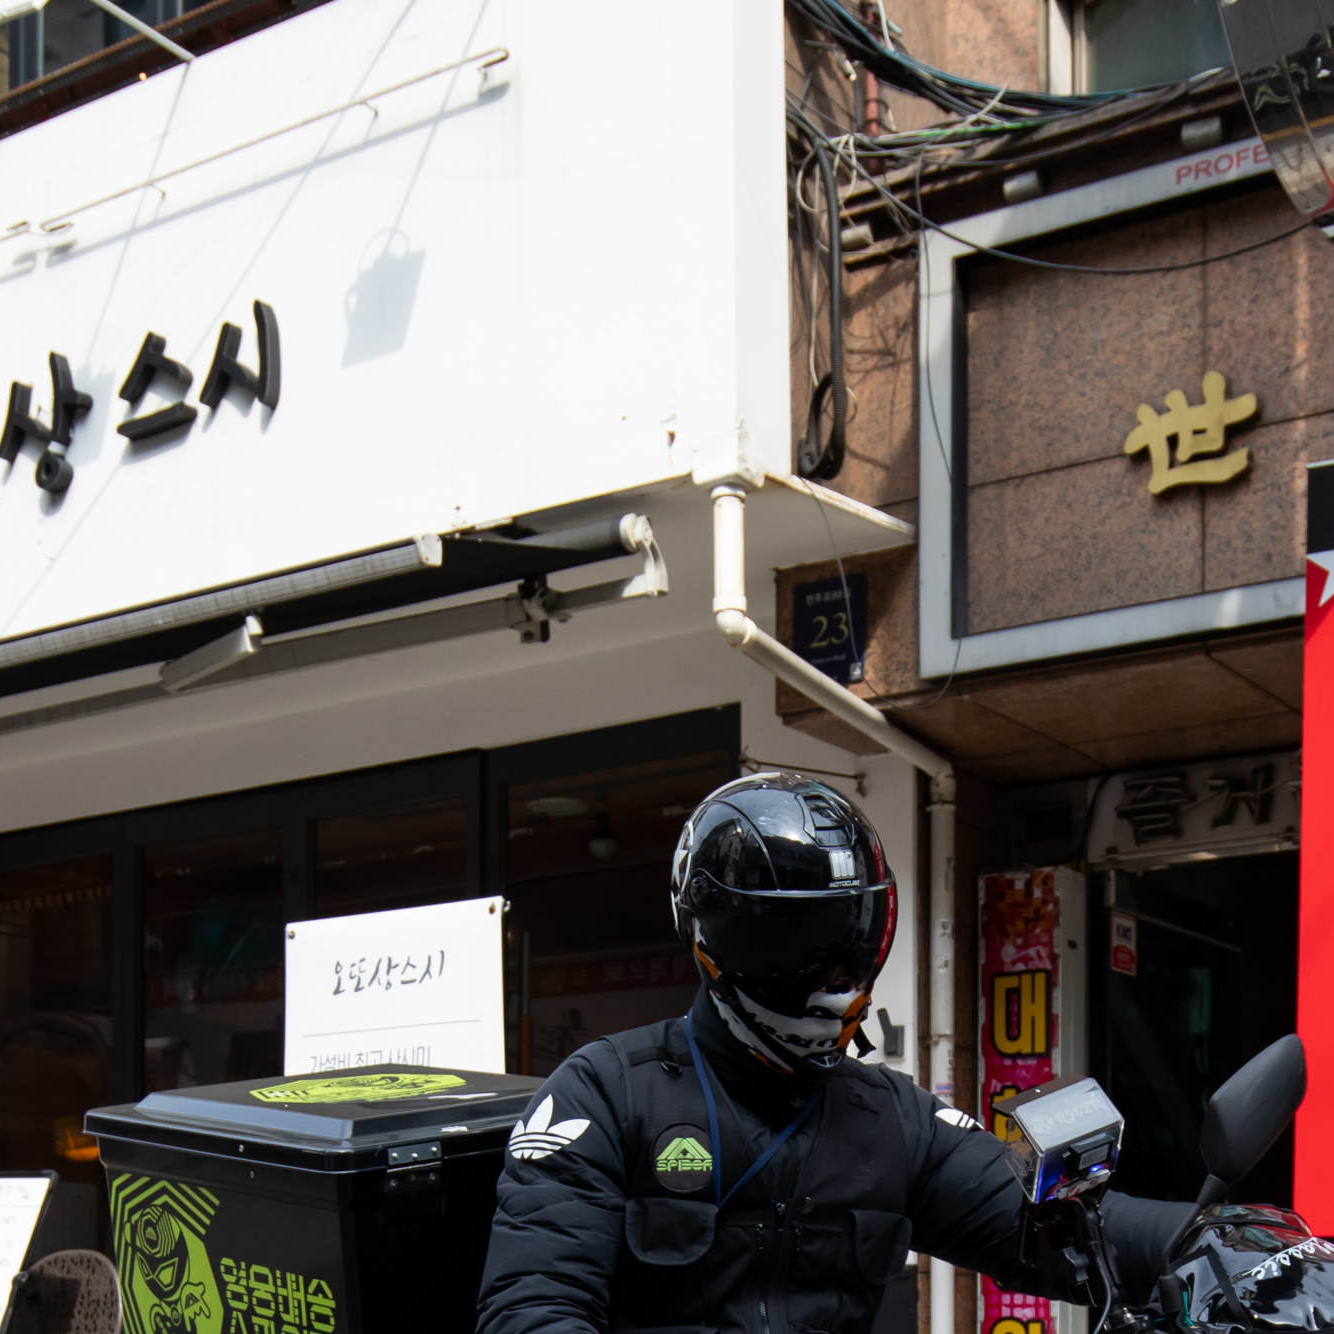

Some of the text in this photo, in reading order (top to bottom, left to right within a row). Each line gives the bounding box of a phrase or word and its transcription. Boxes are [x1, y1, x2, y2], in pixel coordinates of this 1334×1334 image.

[809, 611, 850, 649] 23
[1114, 762, 1301, 846] 즐거
[332, 949, 445, 996] 오또상스시
[220, 1257, 337, 1334] 영웅배송
